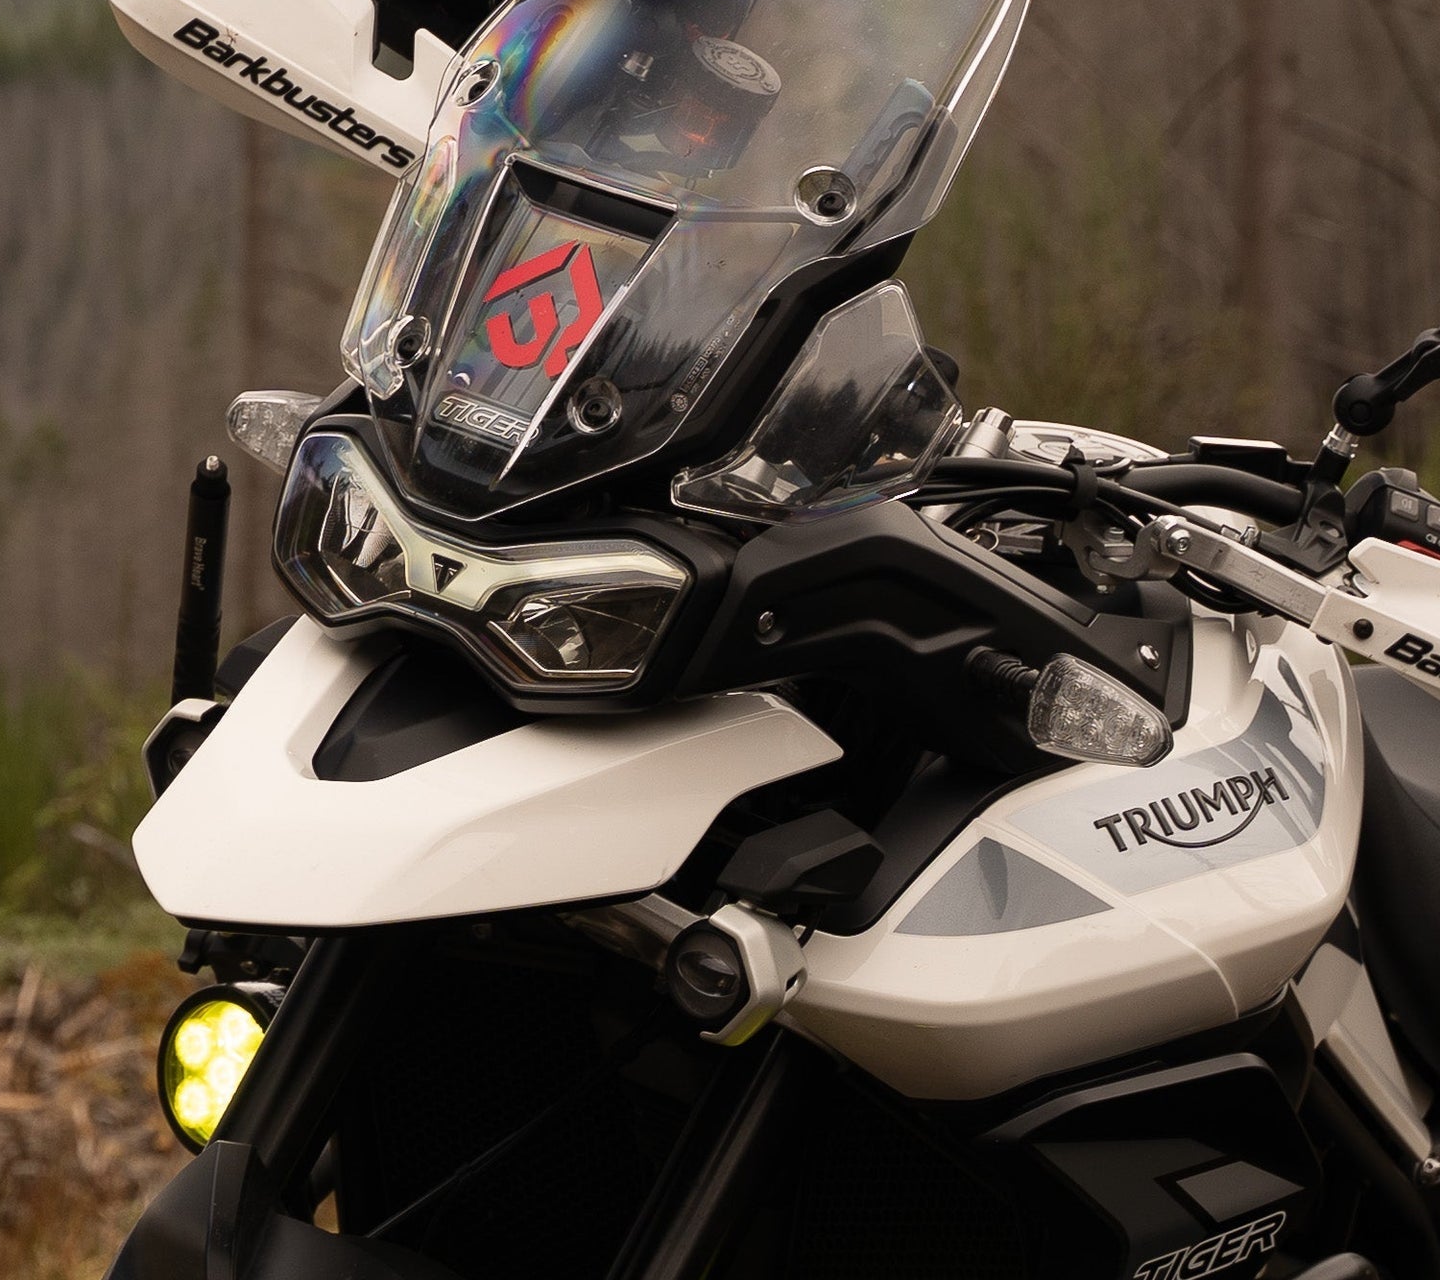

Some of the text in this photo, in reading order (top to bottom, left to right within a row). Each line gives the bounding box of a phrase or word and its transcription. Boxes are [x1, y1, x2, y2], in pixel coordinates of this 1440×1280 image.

[174, 19, 418, 170] Barkbusters
[439, 395, 540, 448] TIGER
[1094, 766, 1289, 853] TRIUMPH
